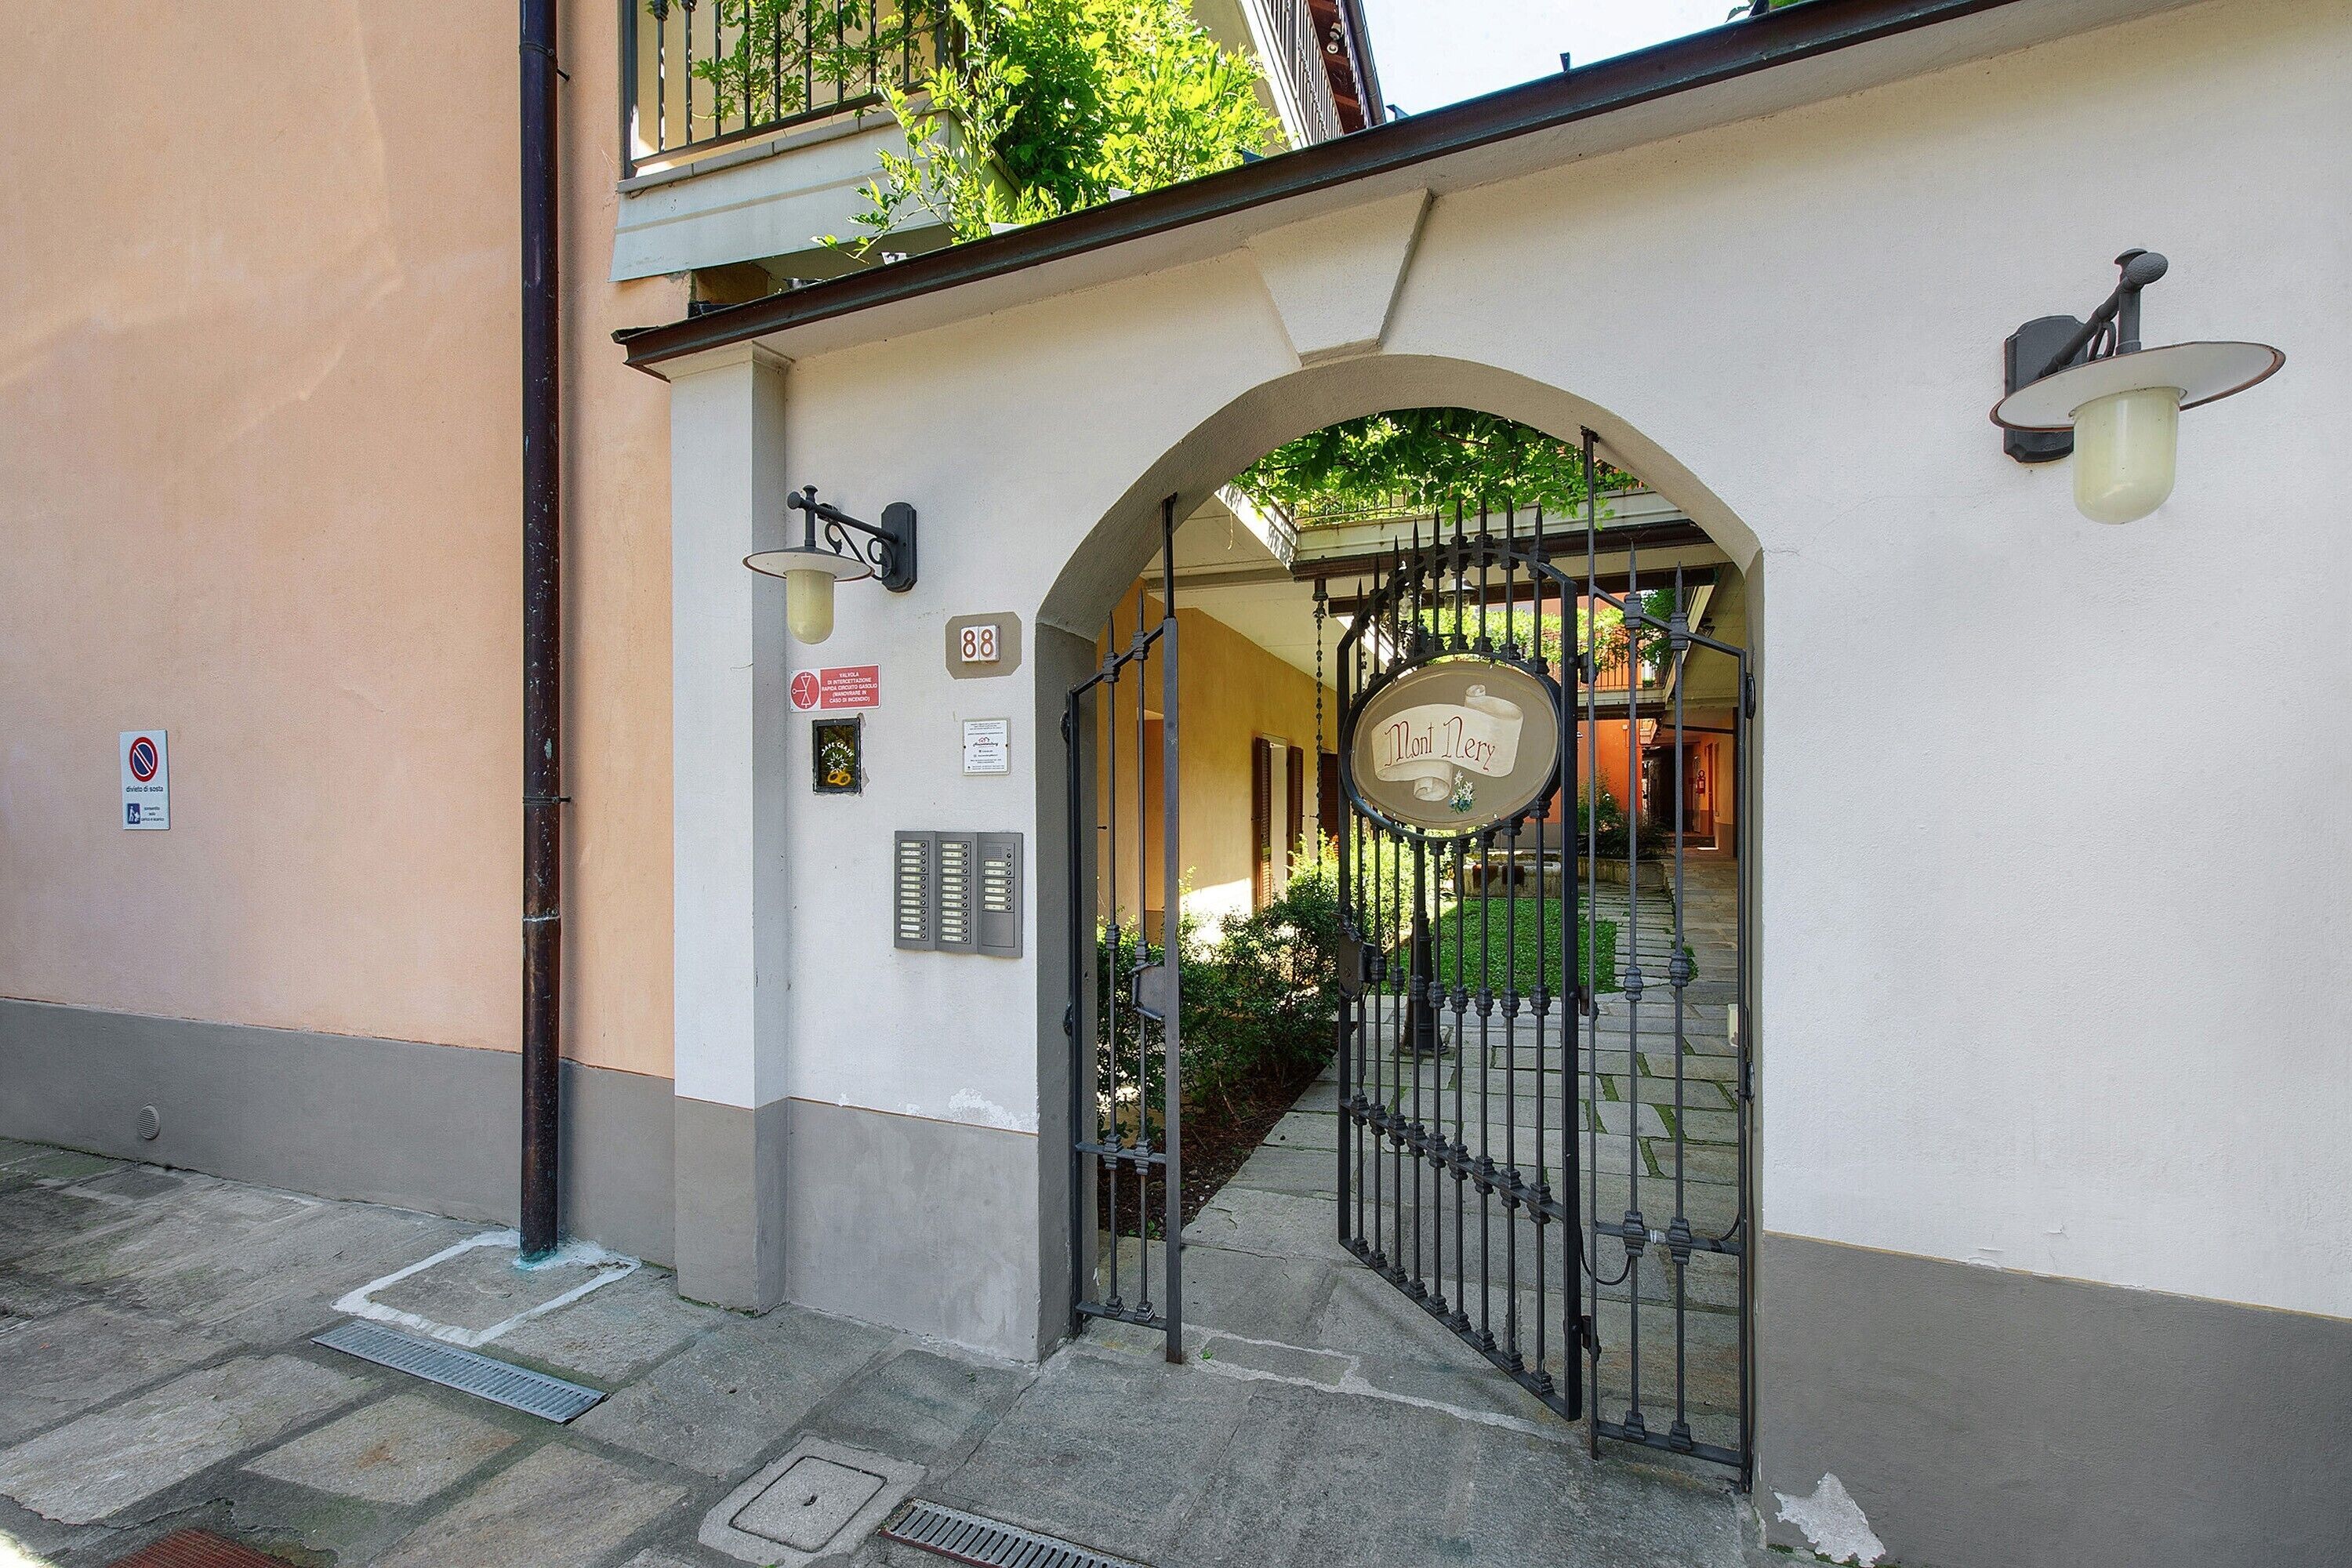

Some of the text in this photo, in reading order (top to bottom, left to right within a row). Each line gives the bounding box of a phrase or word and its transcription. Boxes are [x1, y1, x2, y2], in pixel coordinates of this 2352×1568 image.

[963, 630, 993, 658] 88
[1385, 716, 1496, 771] Mont Nery
